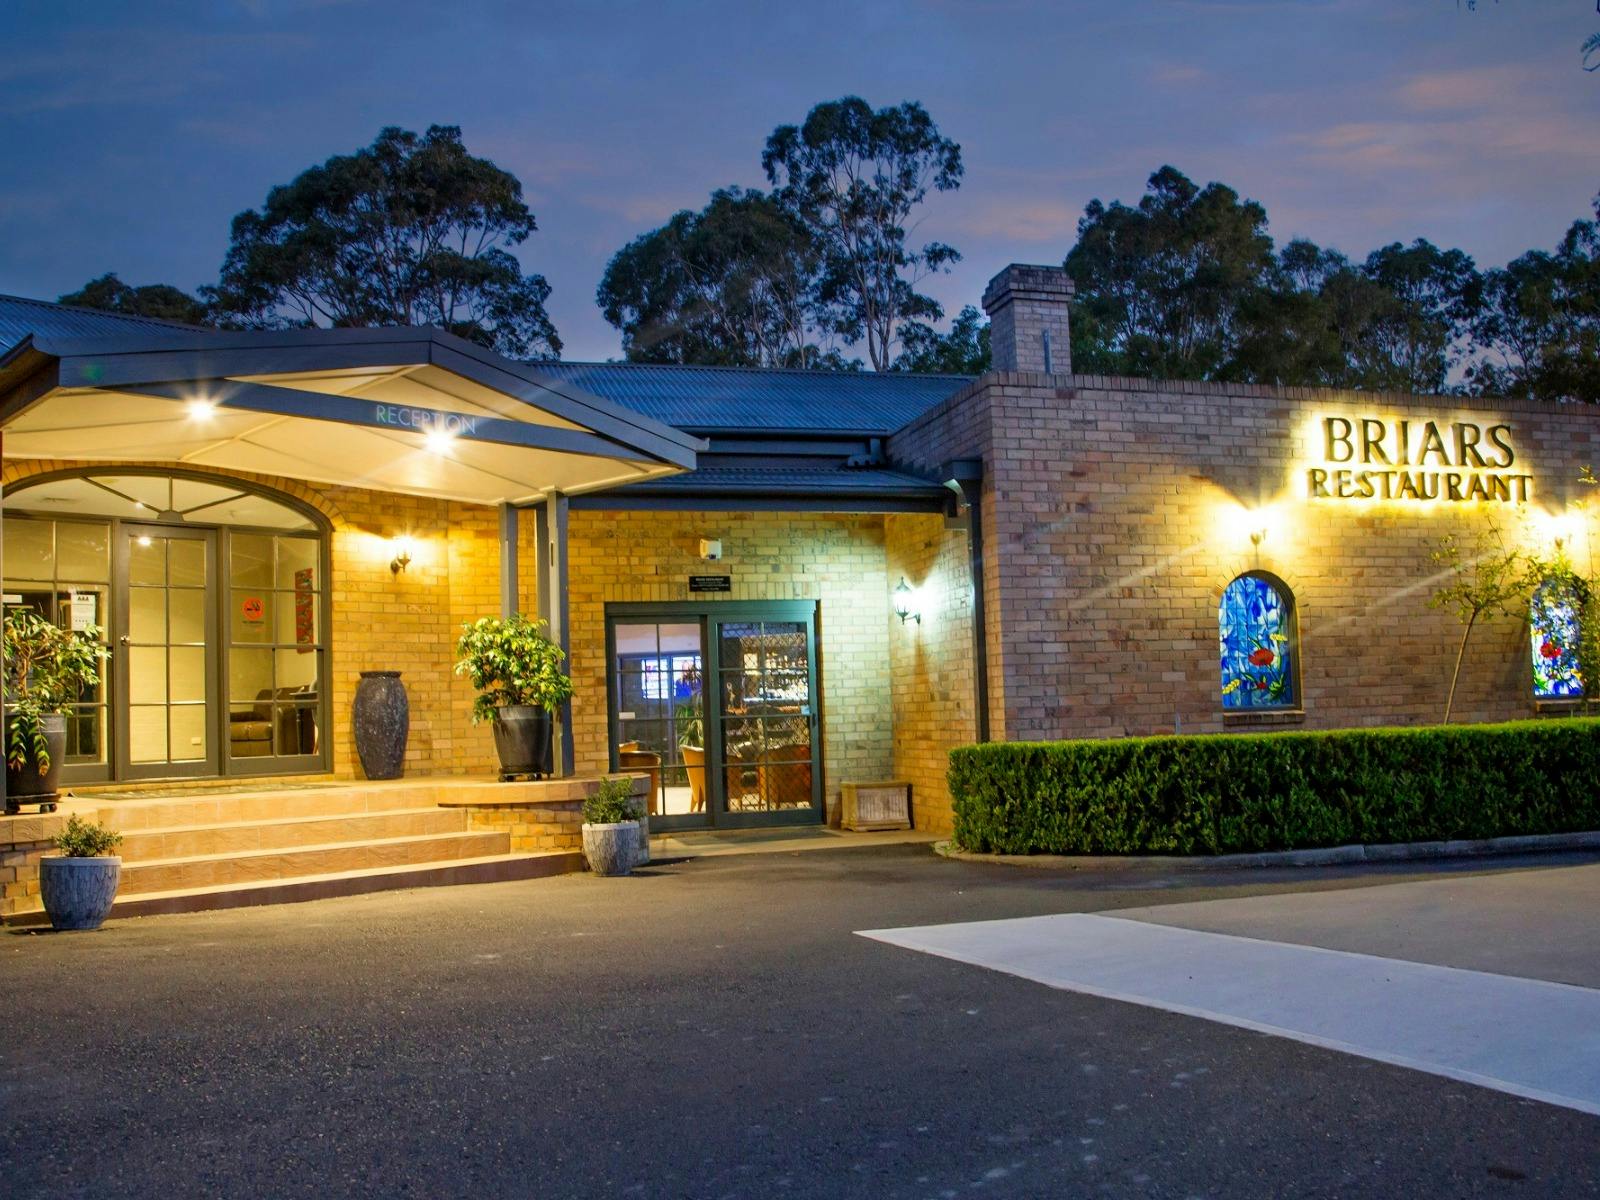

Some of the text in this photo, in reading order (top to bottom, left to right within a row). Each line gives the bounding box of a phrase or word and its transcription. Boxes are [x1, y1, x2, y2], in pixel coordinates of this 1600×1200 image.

[376, 405, 476, 434] RECEPTION
[1323, 417, 1515, 468] BRIARS
[1306, 468, 1534, 502] RESTAURANT
